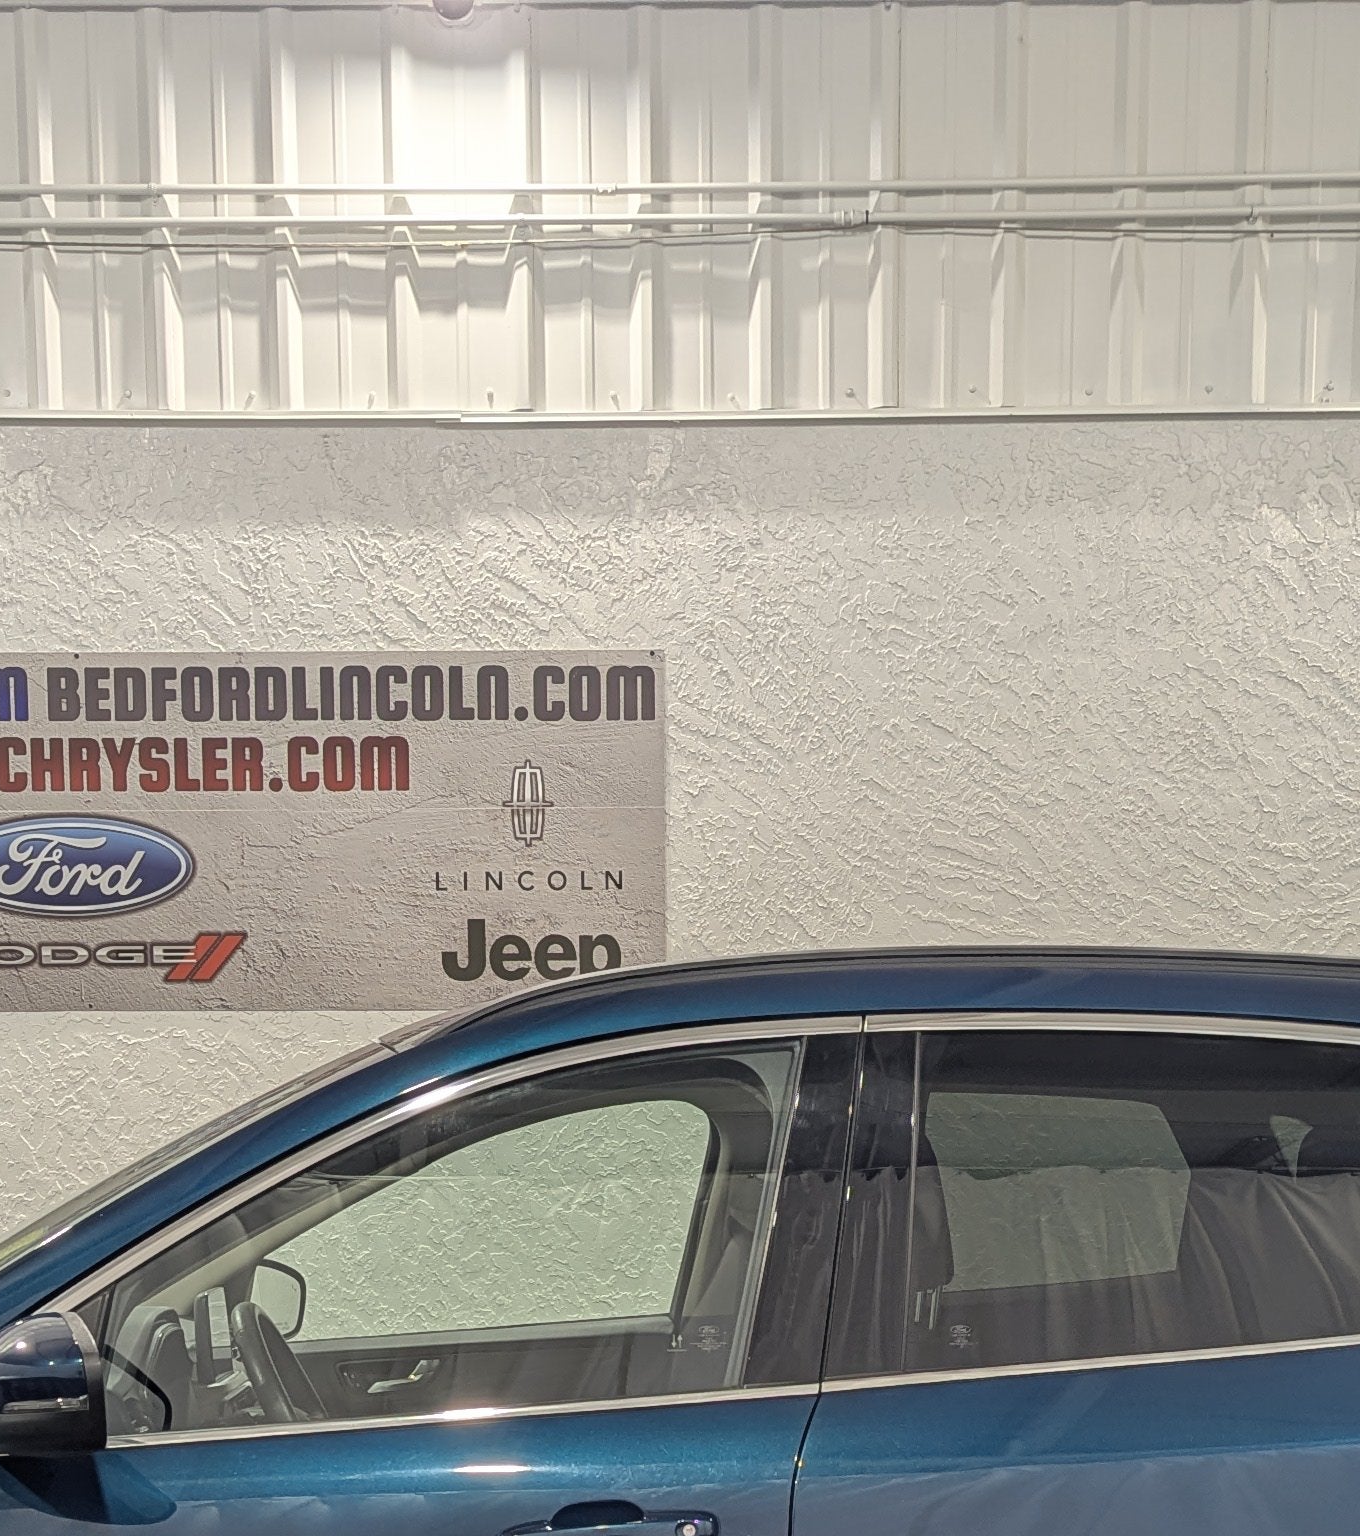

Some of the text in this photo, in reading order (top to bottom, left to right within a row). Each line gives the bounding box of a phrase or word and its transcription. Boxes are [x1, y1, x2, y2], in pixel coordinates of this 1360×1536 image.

[47, 665, 655, 722] BEDFORDLINCOLN.COM
[435, 870, 624, 892] LINCOLN
[441, 919, 622, 982] Jeep
